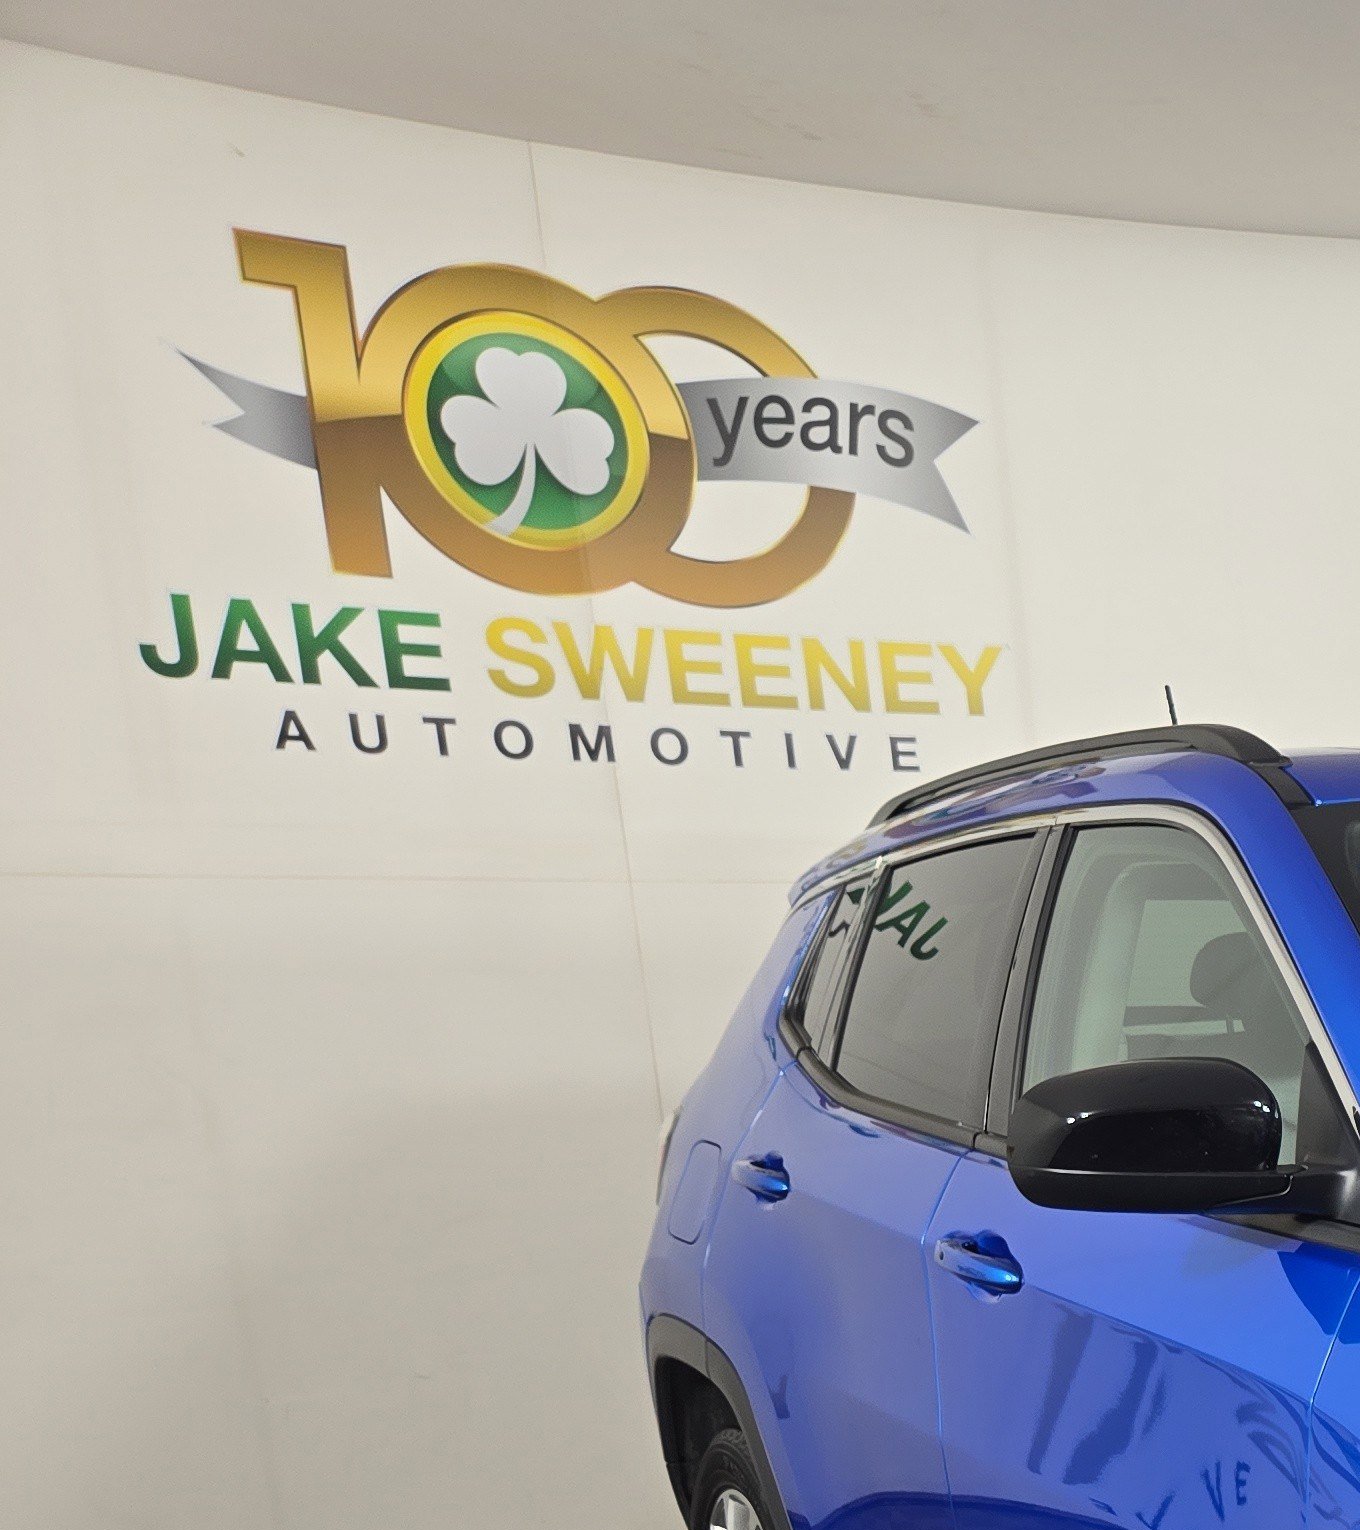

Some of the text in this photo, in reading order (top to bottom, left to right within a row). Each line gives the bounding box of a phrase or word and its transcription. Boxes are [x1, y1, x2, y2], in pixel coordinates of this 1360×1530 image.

[705, 395, 914, 469] years
[139, 594, 1002, 716] JAKE SWEENEY
[273, 711, 920, 772] AUTOMOTIVE
